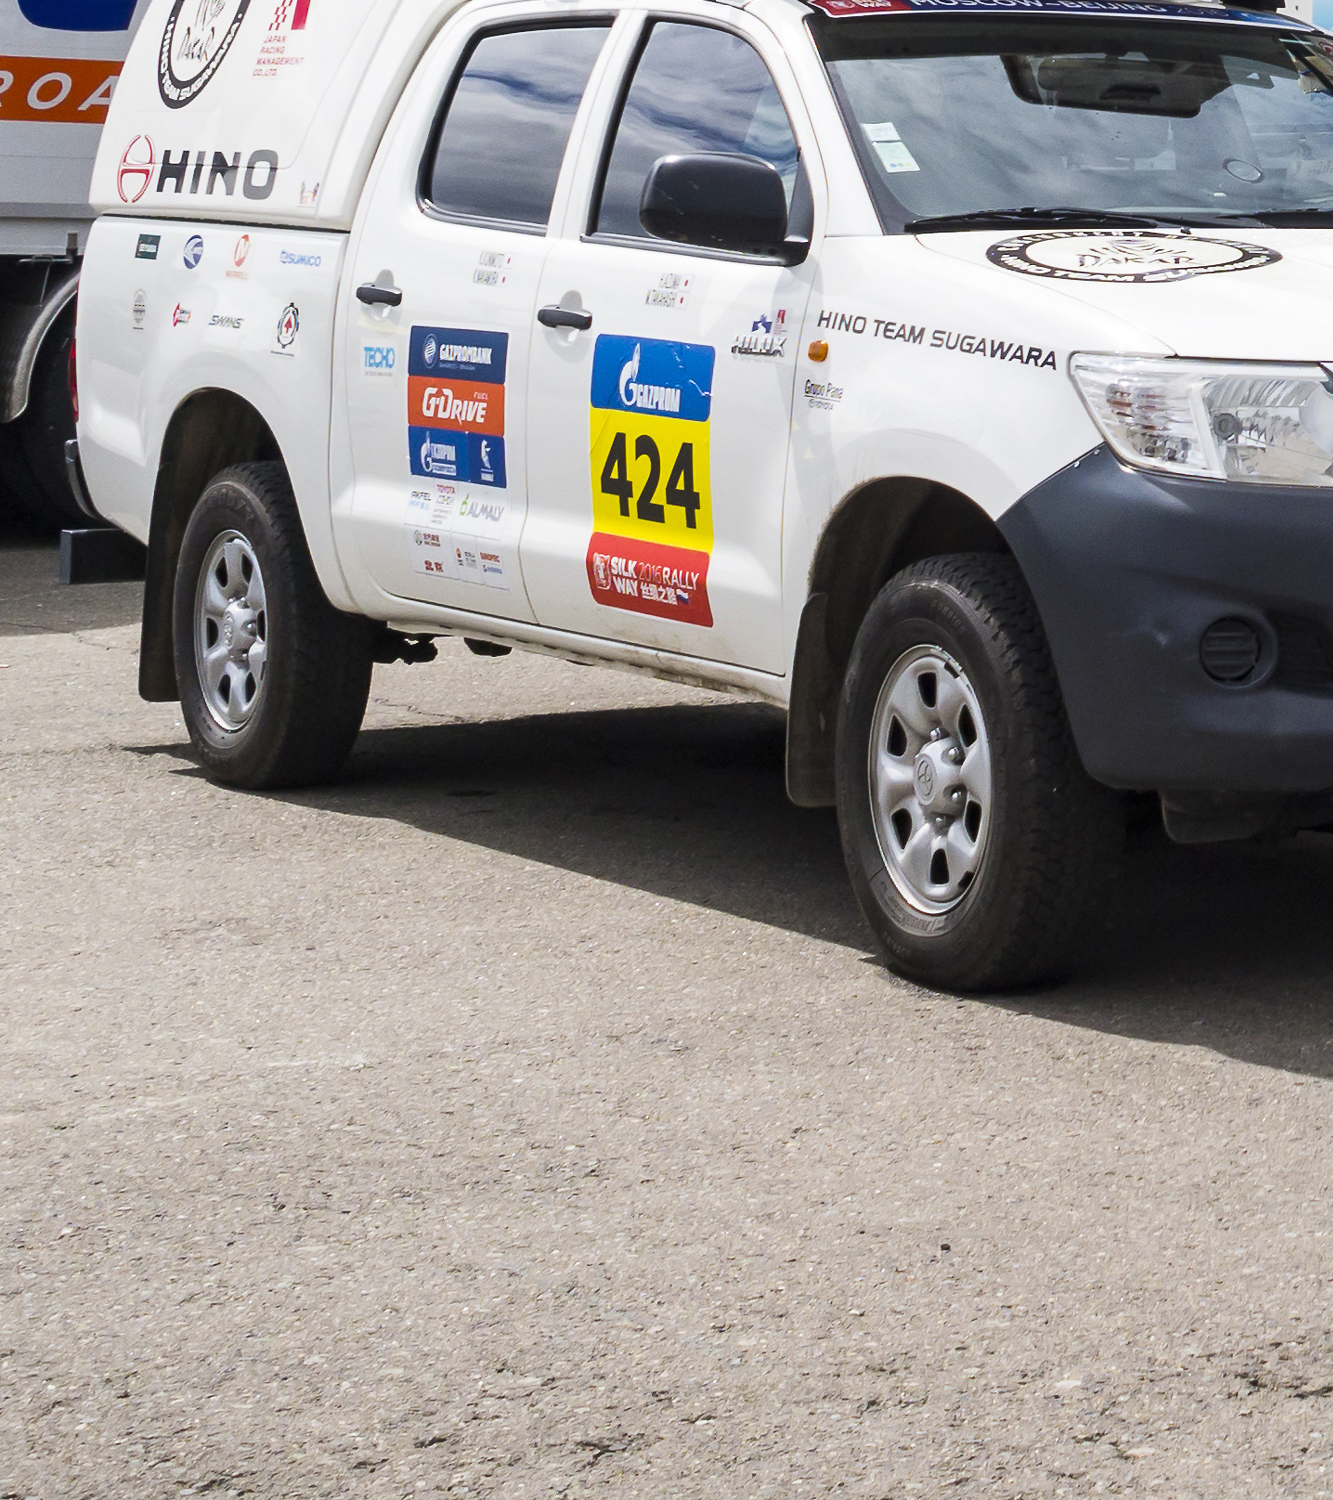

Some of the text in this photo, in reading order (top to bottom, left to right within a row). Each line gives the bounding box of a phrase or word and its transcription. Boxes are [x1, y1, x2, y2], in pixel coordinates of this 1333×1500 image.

[264, 35, 287, 44] JAPAN
[260, 46, 285, 55] RACING
[256, 57, 305, 66] MANAGEMENT
[156, 149, 279, 201] HINO
[1053, 270, 1136, 283] TEAM
[817, 310, 1057, 371] HINO TEAM SUGAWARA
[439, 343, 493, 365] GAZPROMBANK
[636, 385, 682, 413] GAZPROM
[600, 431, 701, 529] 424
[467, 502, 504, 522] ALMALY
[610, 556, 700, 591] SILK 2016 RALLY
[612, 576, 639, 597] WAY
